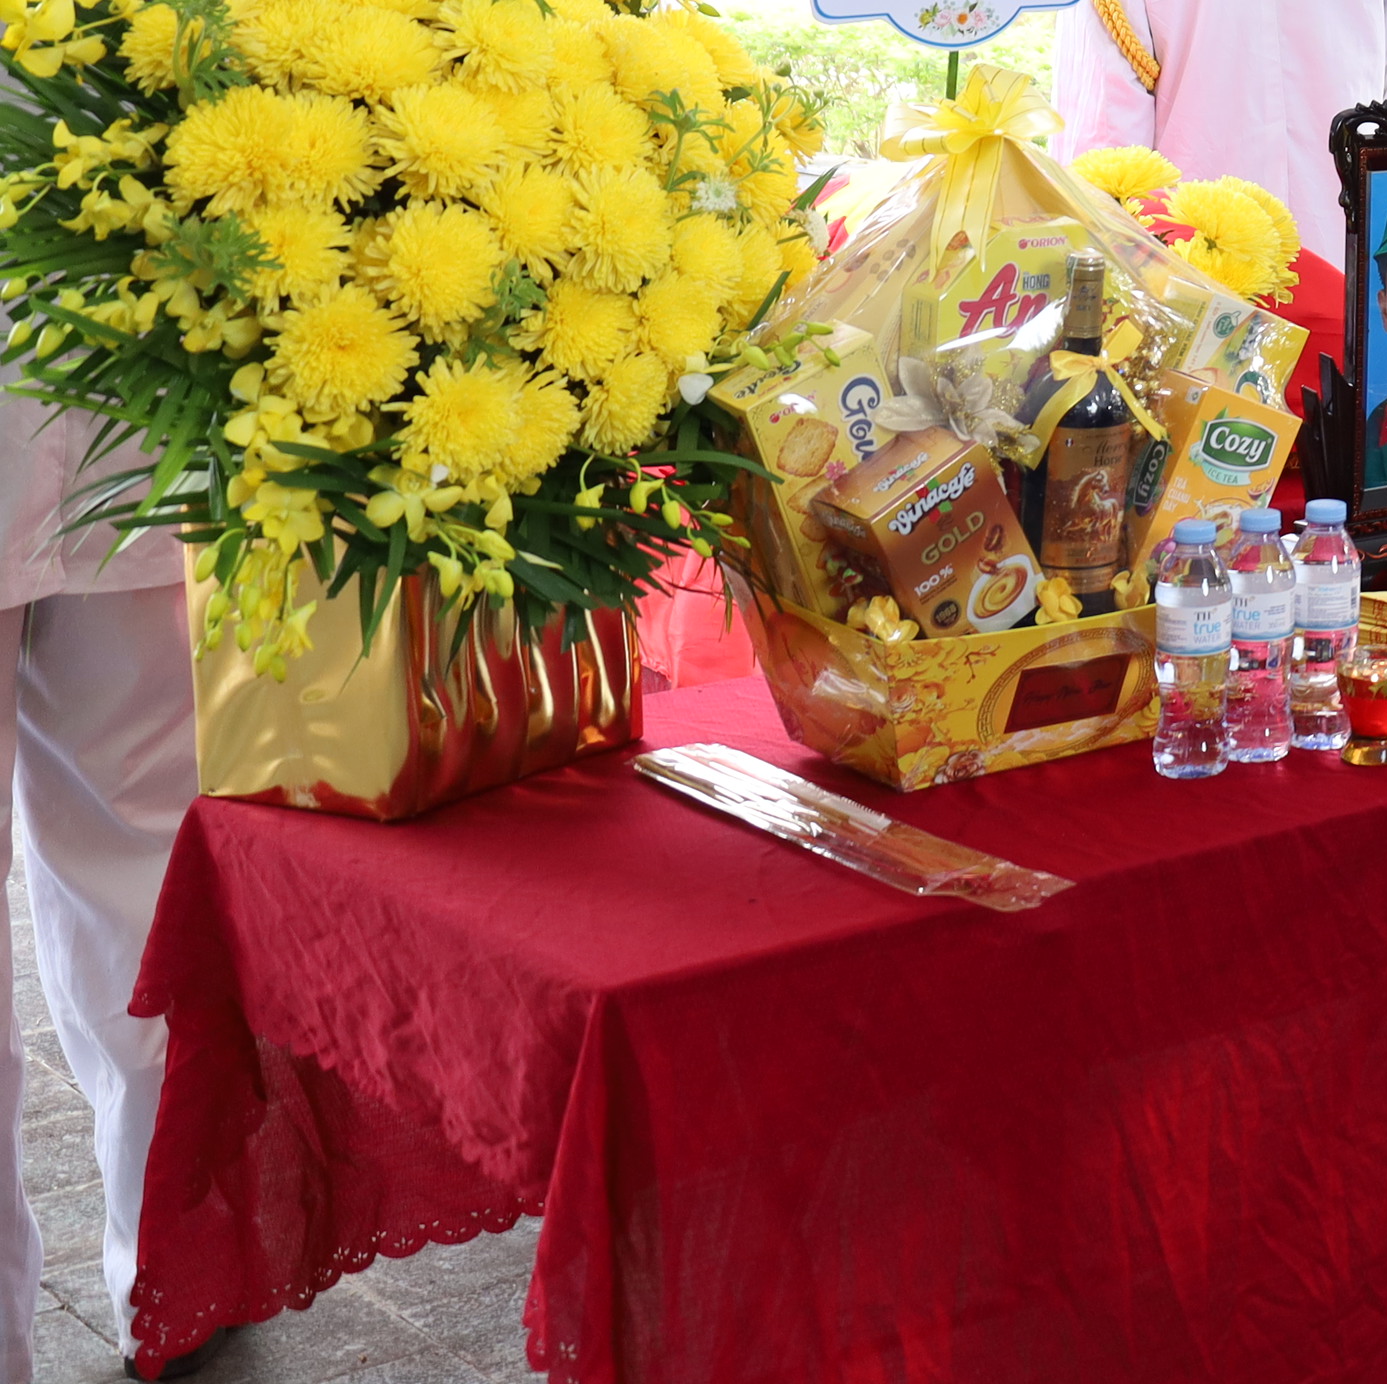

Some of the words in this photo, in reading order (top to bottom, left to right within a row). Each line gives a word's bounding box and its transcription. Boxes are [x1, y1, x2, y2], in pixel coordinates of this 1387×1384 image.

[1030, 236, 1066, 248] ORION
[1210, 426, 1266, 463] Cozy
[1137, 444, 1165, 498] Cozy
[1207, 468, 1221, 480] ICE
[1223, 473, 1239, 484] TEA
[888, 462, 976, 535] Vinacafé
[921, 511, 984, 565] GOLD
[1232, 608, 1260, 621] true
[1193, 621, 1221, 635] true
[1232, 621, 1261, 630] WATER
[1194, 634, 1221, 644] WATER
